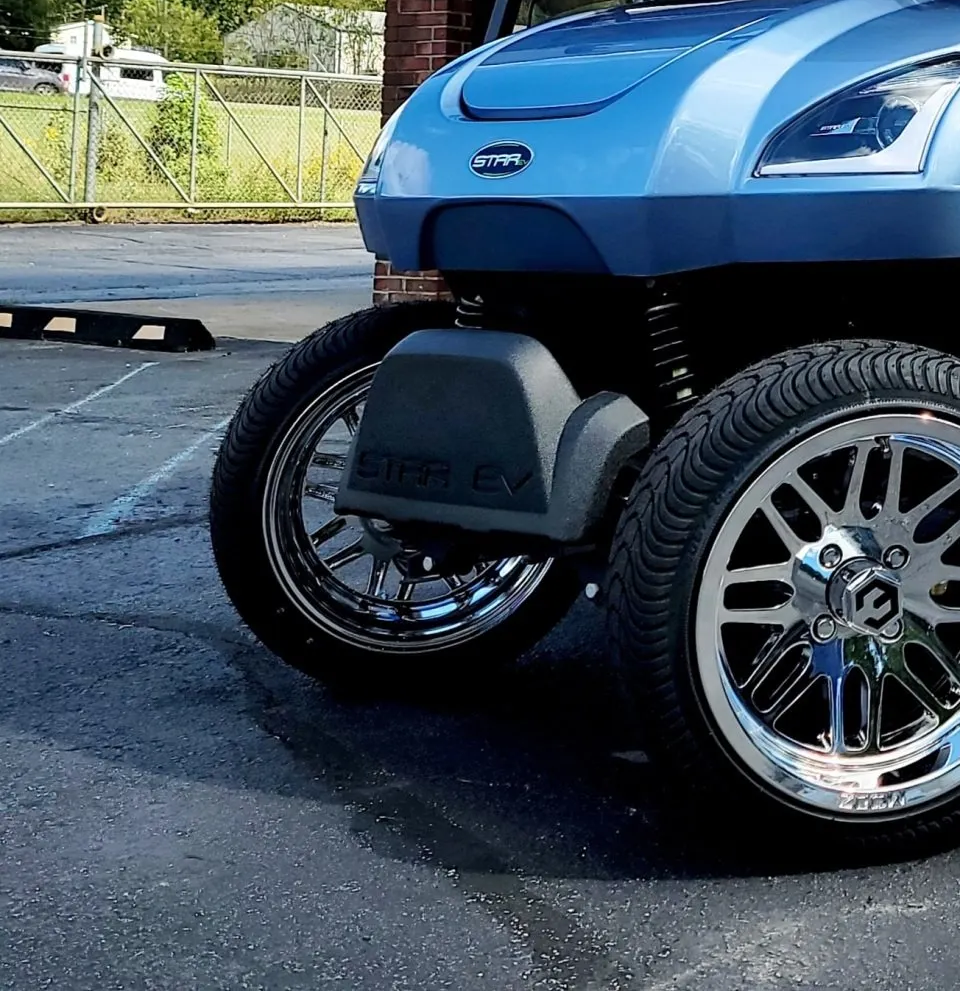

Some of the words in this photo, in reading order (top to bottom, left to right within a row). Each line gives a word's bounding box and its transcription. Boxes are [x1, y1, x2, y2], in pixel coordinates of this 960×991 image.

[472, 153, 522, 168] STAR
[355, 449, 451, 489] STAR
[472, 464, 534, 497] EV
